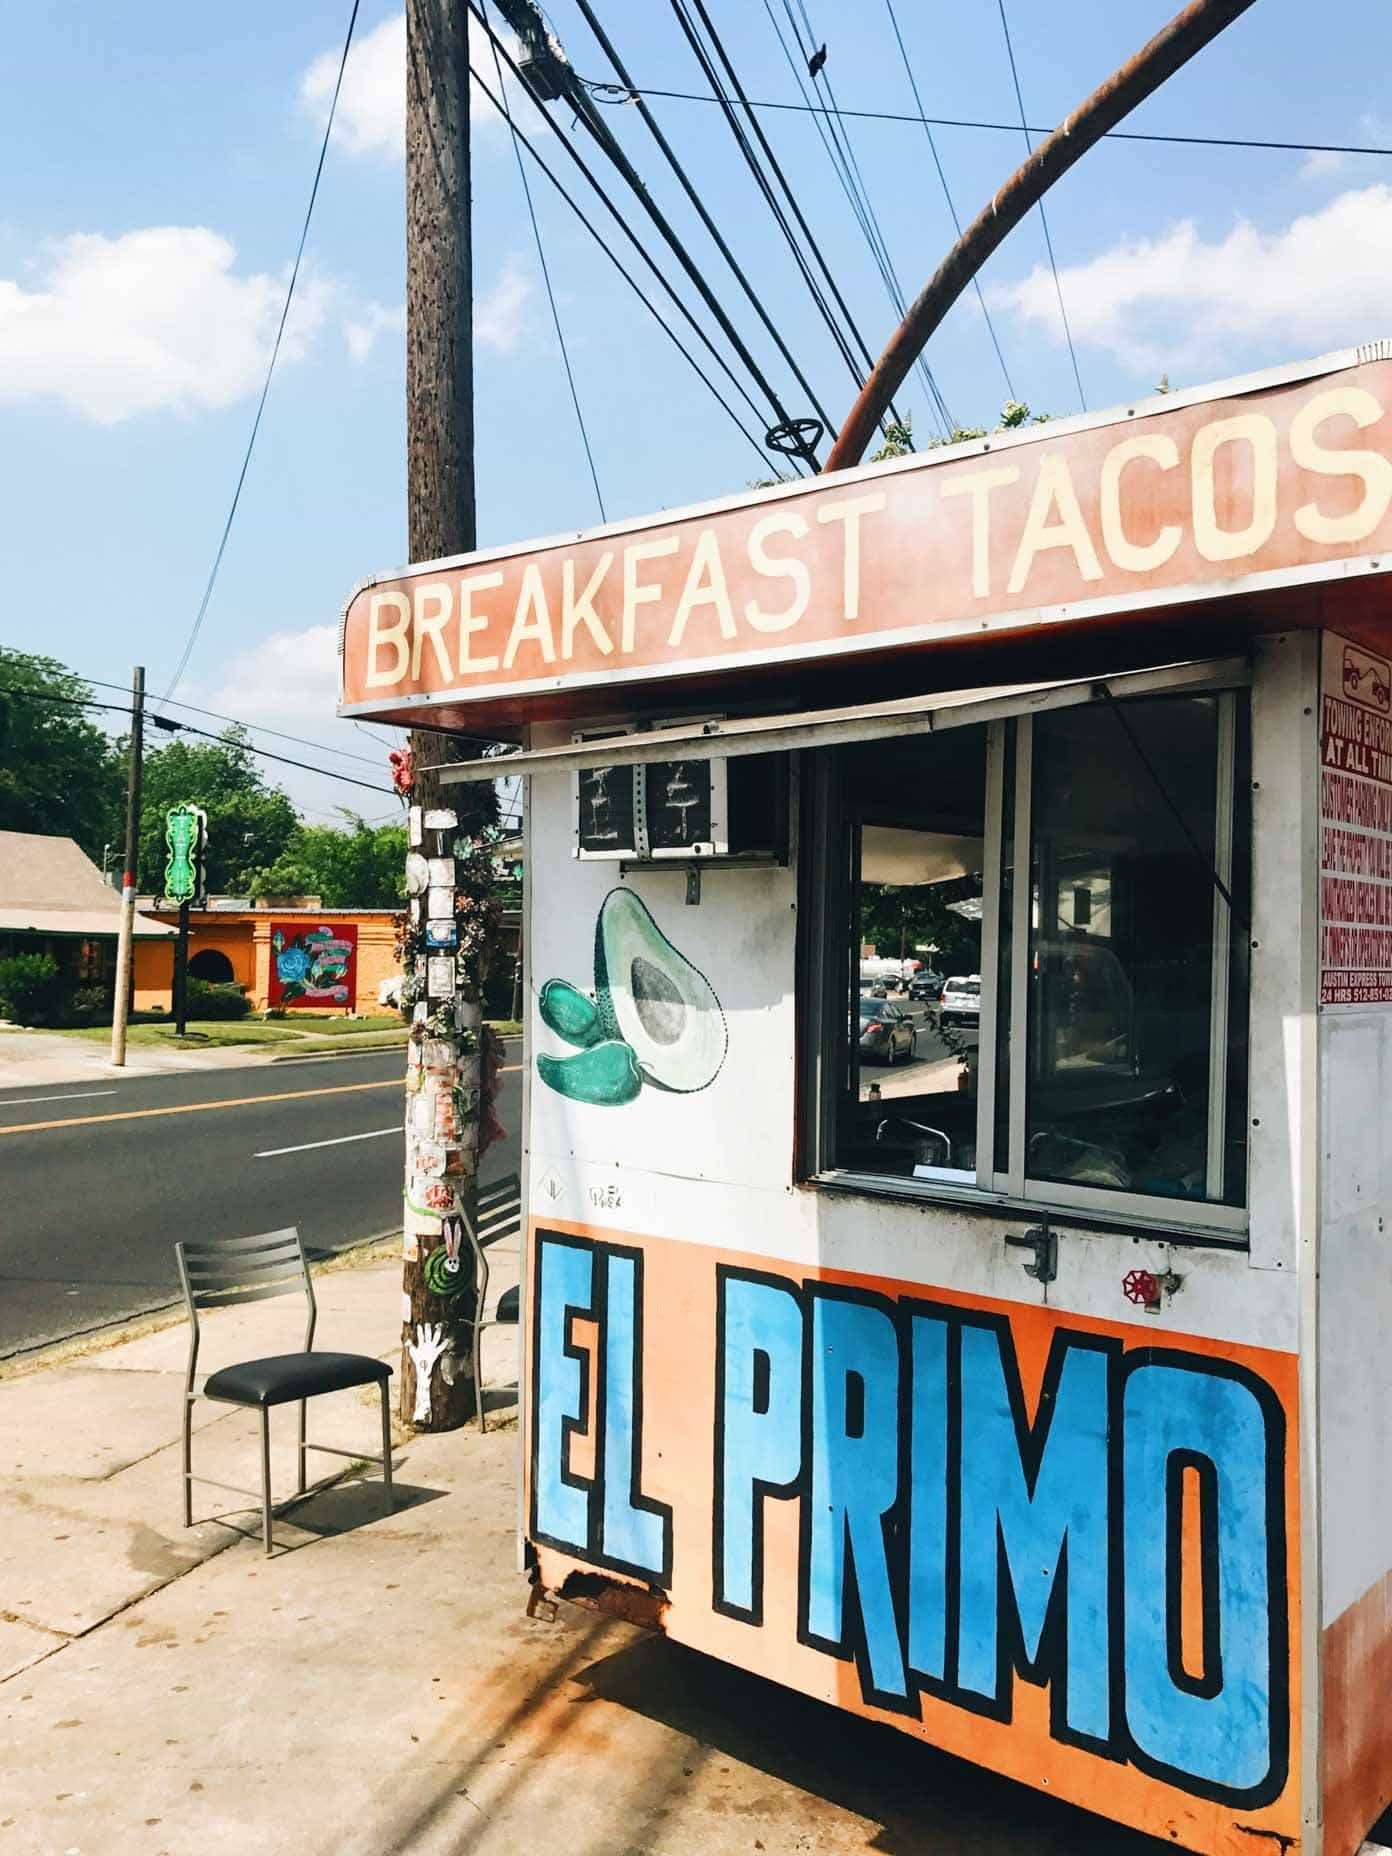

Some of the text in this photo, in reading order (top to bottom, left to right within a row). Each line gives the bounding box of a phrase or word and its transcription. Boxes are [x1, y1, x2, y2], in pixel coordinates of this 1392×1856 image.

[365, 387, 1392, 688] BREAKFAST TACOS
[1325, 698, 1362, 742] TOWING
[1326, 736, 1344, 766] AT
[1346, 743, 1369, 773] ALL
[1321, 988, 1332, 1002] 24
[1334, 988, 1352, 1002] HRS
[1323, 972, 1348, 987] AUSTIN
[1349, 972, 1377, 987] EXPRESS
[531, 1227, 1288, 1809] EL PRIMO
